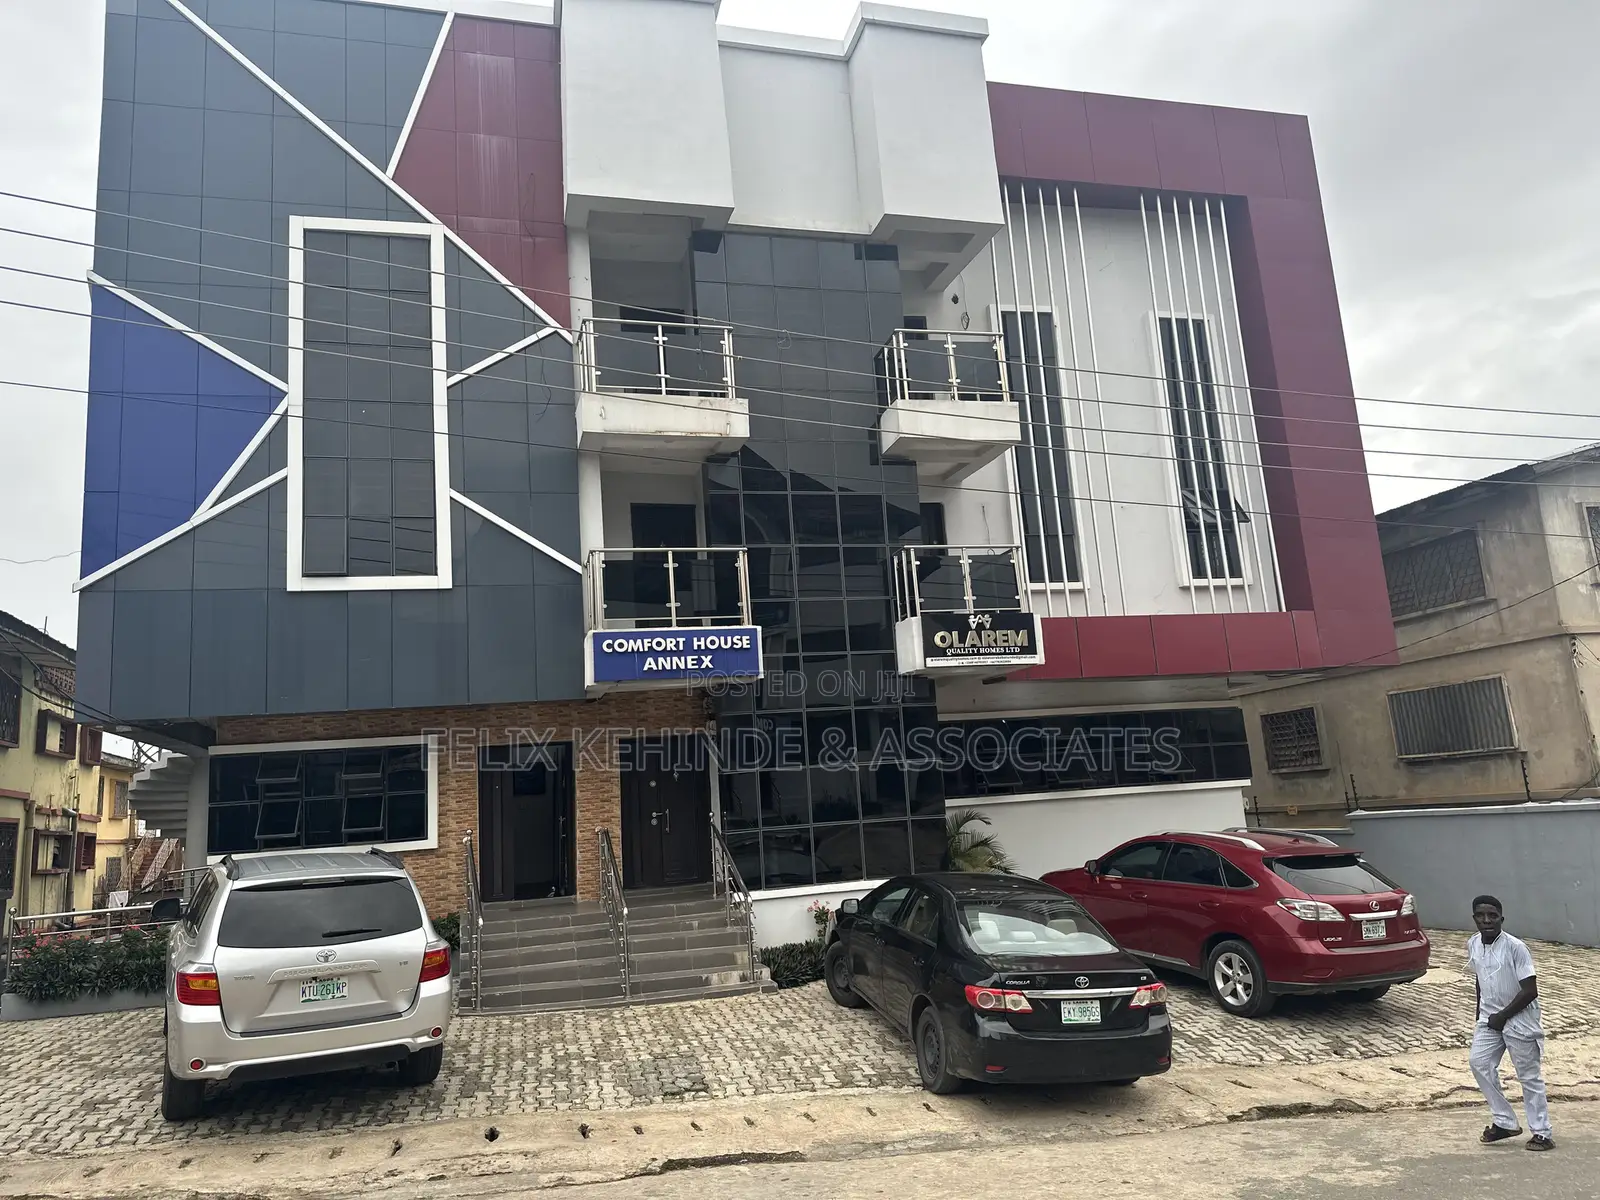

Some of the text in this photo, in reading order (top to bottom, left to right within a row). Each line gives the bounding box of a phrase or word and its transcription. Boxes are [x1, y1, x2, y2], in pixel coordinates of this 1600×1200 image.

[602, 635, 751, 653] COMFORT HOUSE
[934, 630, 1028, 648] OLAREM
[946, 647, 978, 656] QUALITY
[643, 655, 714, 671] ANNEX
